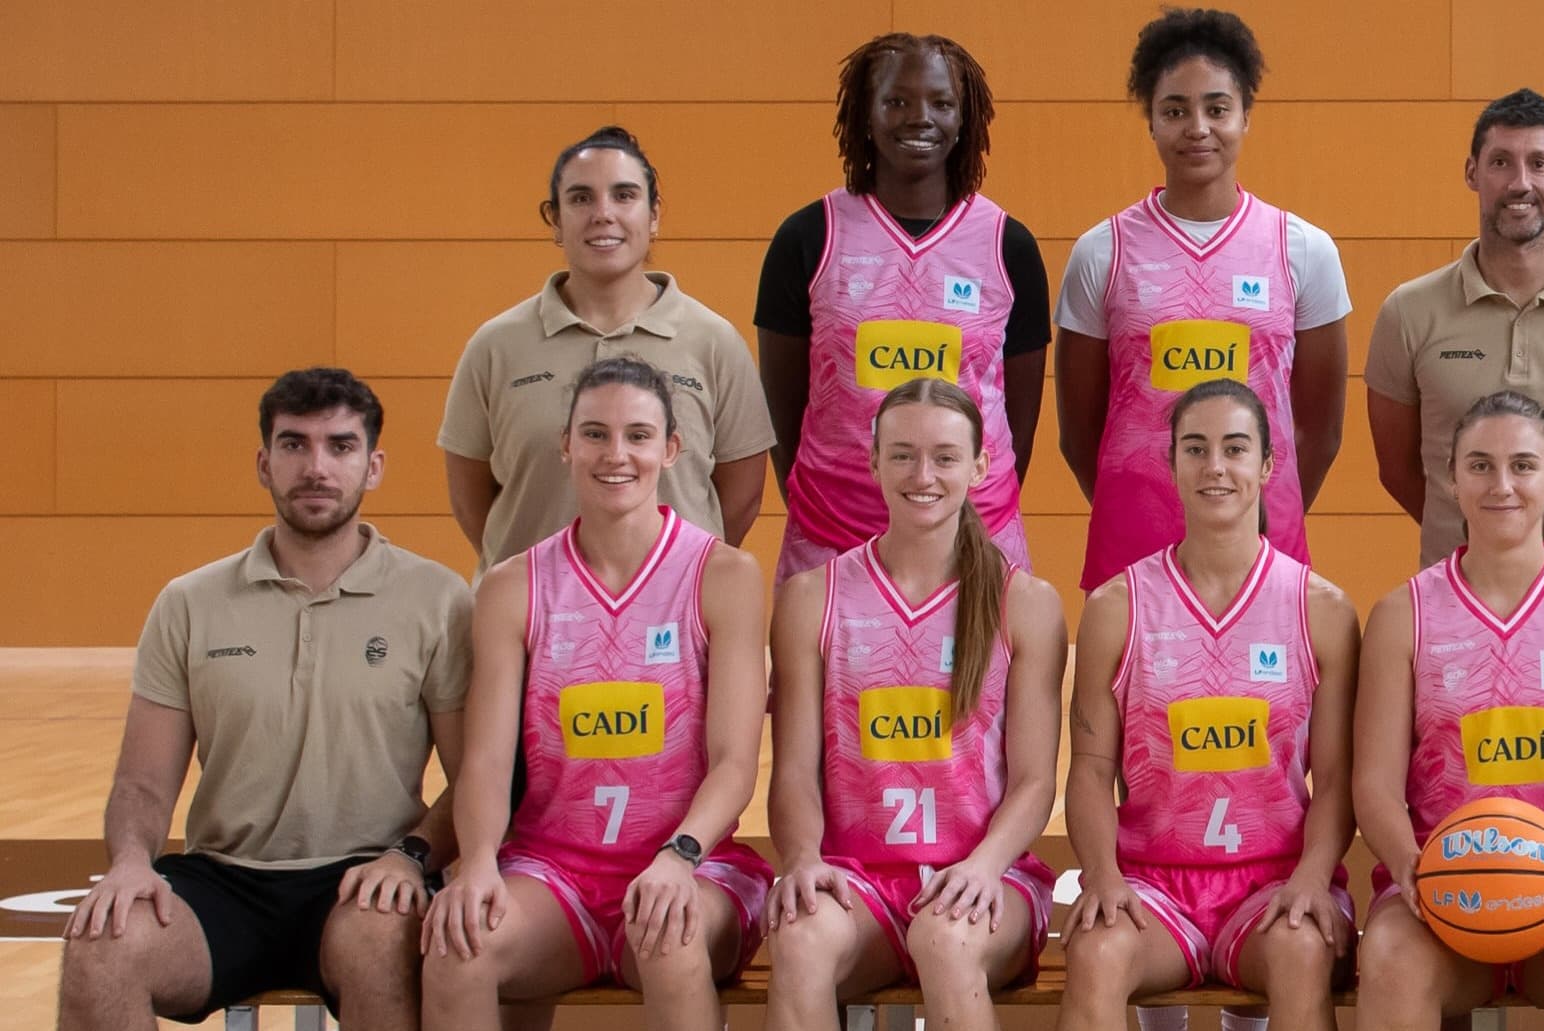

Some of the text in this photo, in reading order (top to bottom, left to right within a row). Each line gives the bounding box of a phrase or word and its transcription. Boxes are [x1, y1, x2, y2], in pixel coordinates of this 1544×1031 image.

[869, 343, 947, 372] CADÍ
[1162, 343, 1237, 372] CADÍ
[572, 703, 649, 737] CADÍ
[870, 709, 943, 740] CADÍ
[1181, 719, 1257, 751] CADÍ
[594, 785, 629, 844] 7
[883, 788, 937, 844] 21
[1203, 797, 1243, 853] 4
[1433, 888, 1454, 906] LF
